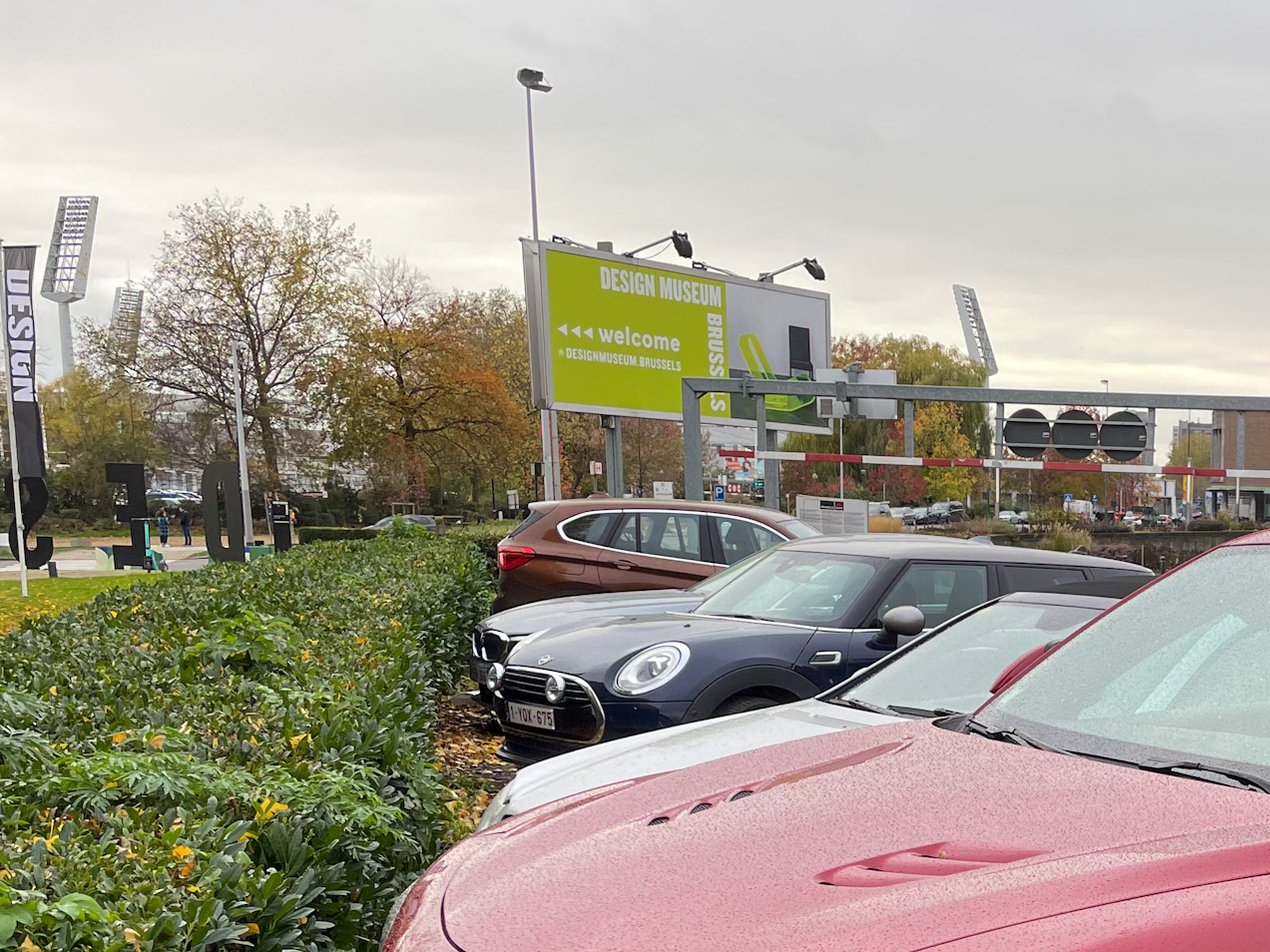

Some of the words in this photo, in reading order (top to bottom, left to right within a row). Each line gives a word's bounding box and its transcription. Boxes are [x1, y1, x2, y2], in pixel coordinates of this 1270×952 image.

[600, 266, 656, 297] DESIGN
[659, 276, 722, 308] MUSEUM
[6, 269, 37, 402] DESIGN
[598, 325, 681, 353] welcome
[565, 347, 682, 372] DESIGNMUSEUM.BRUSSELS
[707, 312, 727, 412] BRUSSLS
[715, 486, 723, 498] P
